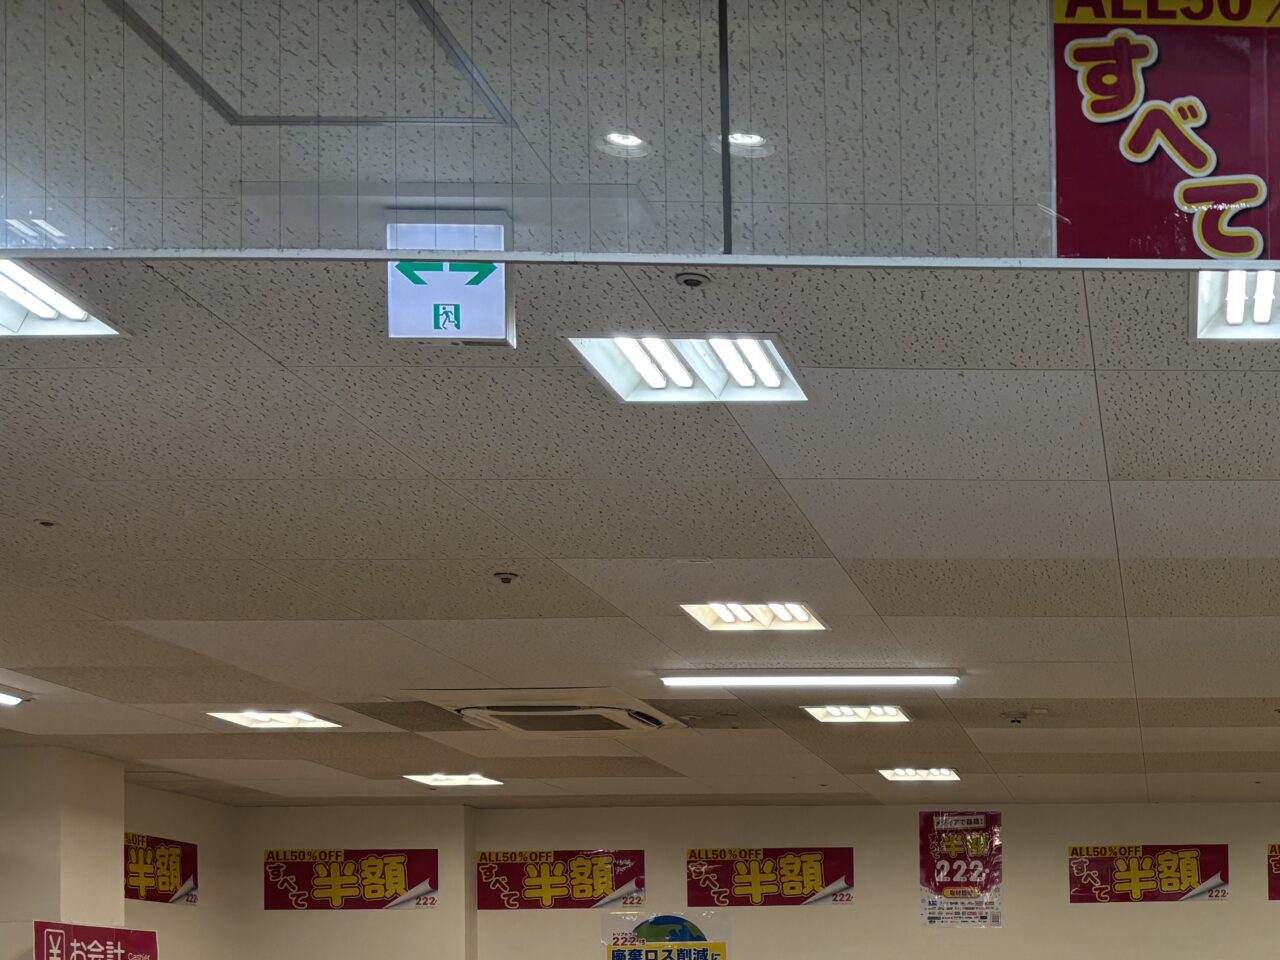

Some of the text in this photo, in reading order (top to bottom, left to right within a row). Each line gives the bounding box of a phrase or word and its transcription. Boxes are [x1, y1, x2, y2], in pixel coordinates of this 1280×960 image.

[1064, 27, 1267, 259] すべて
[127, 843, 182, 899] 半額
[266, 851, 342, 861] ALL50%OFF
[479, 852, 553, 863] ALL50%OFF
[688, 852, 825, 905] すべて 半額
[689, 849, 762, 860] ALL50%OFF
[1070, 847, 1141, 857] ALL50%OFF
[1071, 849, 1202, 902] すべて 半額
[266, 854, 408, 909] すべて 半額
[479, 854, 616, 909] すべて 半額
